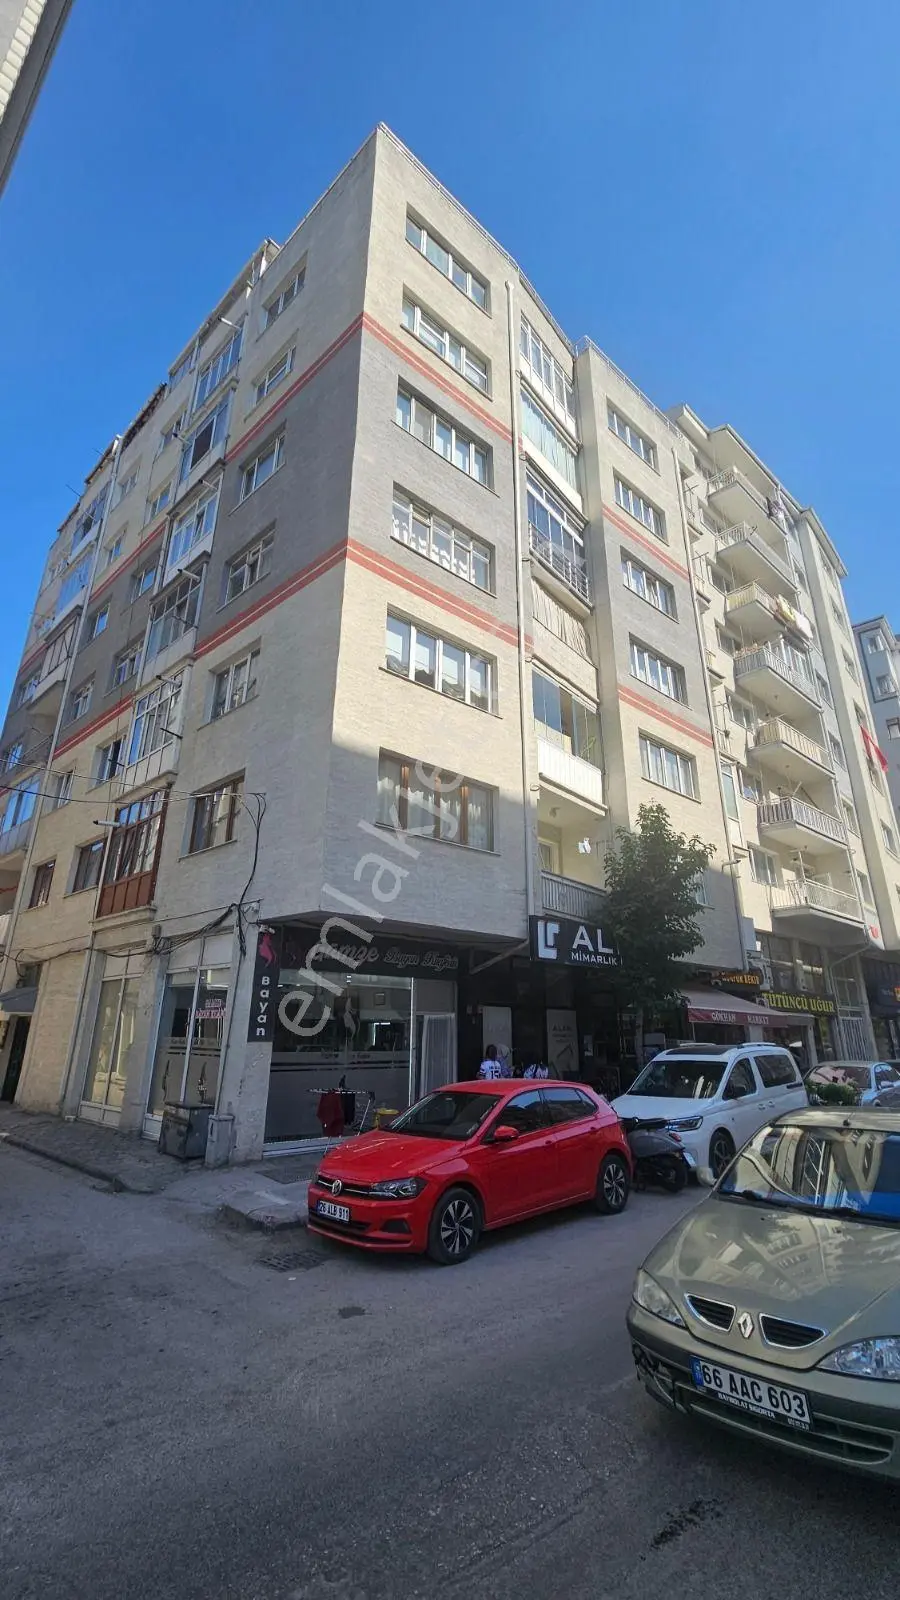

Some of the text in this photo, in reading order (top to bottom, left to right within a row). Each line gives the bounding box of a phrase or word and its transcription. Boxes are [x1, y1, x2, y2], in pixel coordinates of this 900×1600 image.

[571, 950, 617, 966] MİMARLIK
[256, 976, 270, 1036] Bayan
[762, 991, 836, 1013] TÜTÜNCÜ UĞUR
[701, 1364, 806, 1418] 66 AAC 603
